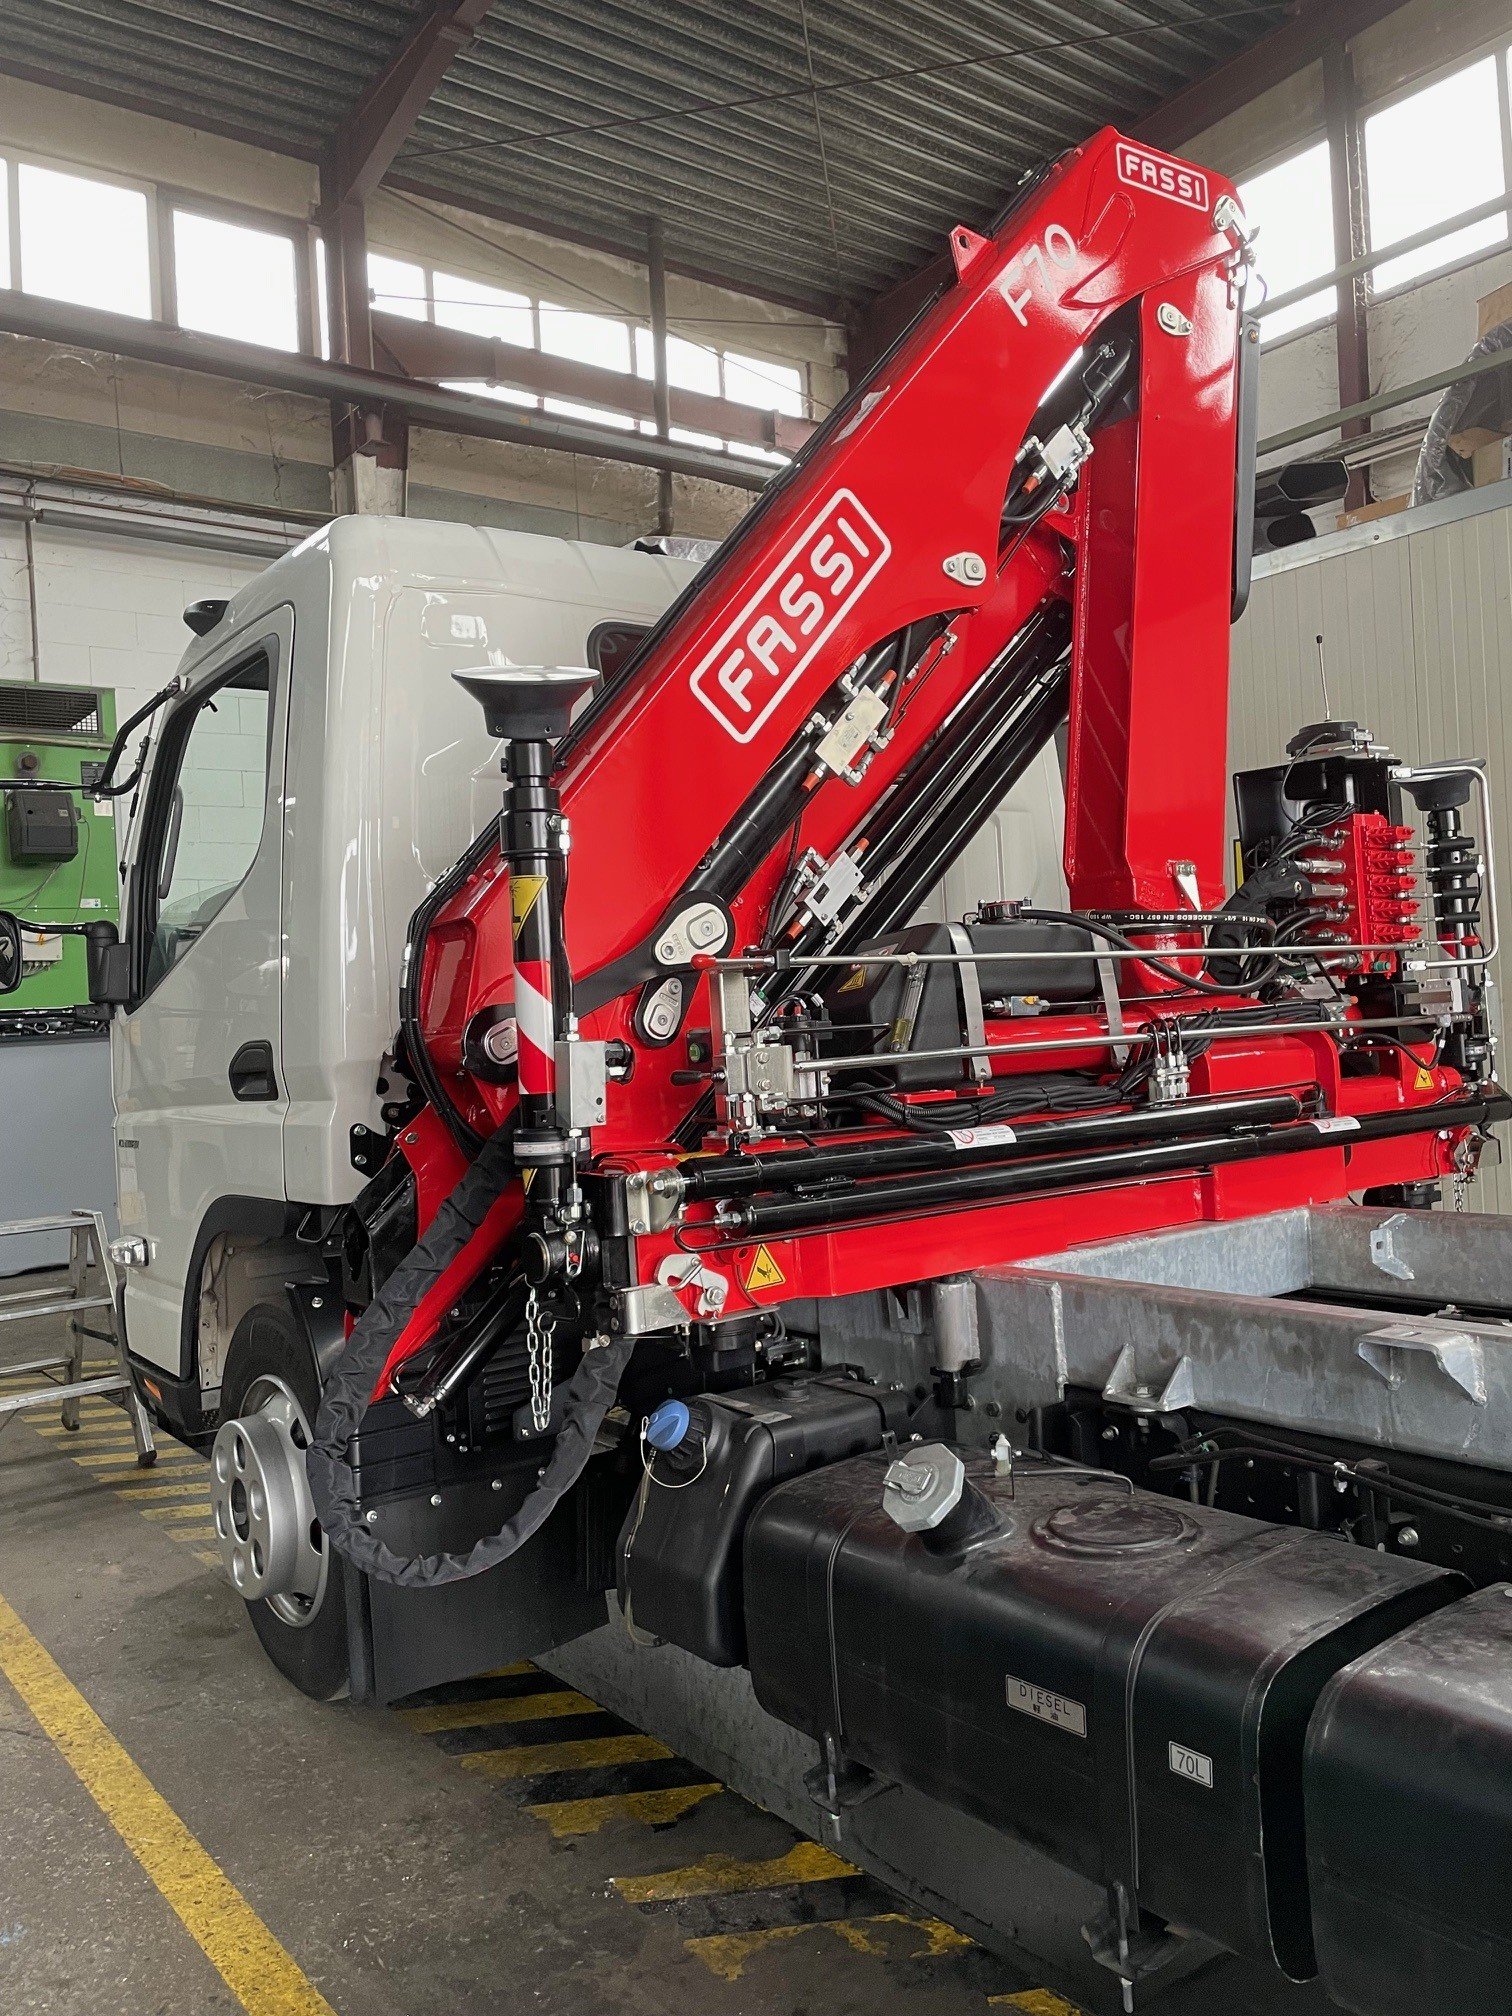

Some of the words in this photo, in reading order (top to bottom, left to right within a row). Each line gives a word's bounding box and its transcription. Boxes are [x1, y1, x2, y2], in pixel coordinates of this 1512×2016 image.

[1125, 154, 1201, 202] FASSI
[1000, 223, 1076, 327] F70
[718, 517, 870, 712] FASSI
[1019, 1684, 1071, 1716] DIESEL
[1177, 1750, 1205, 1779] 70L
